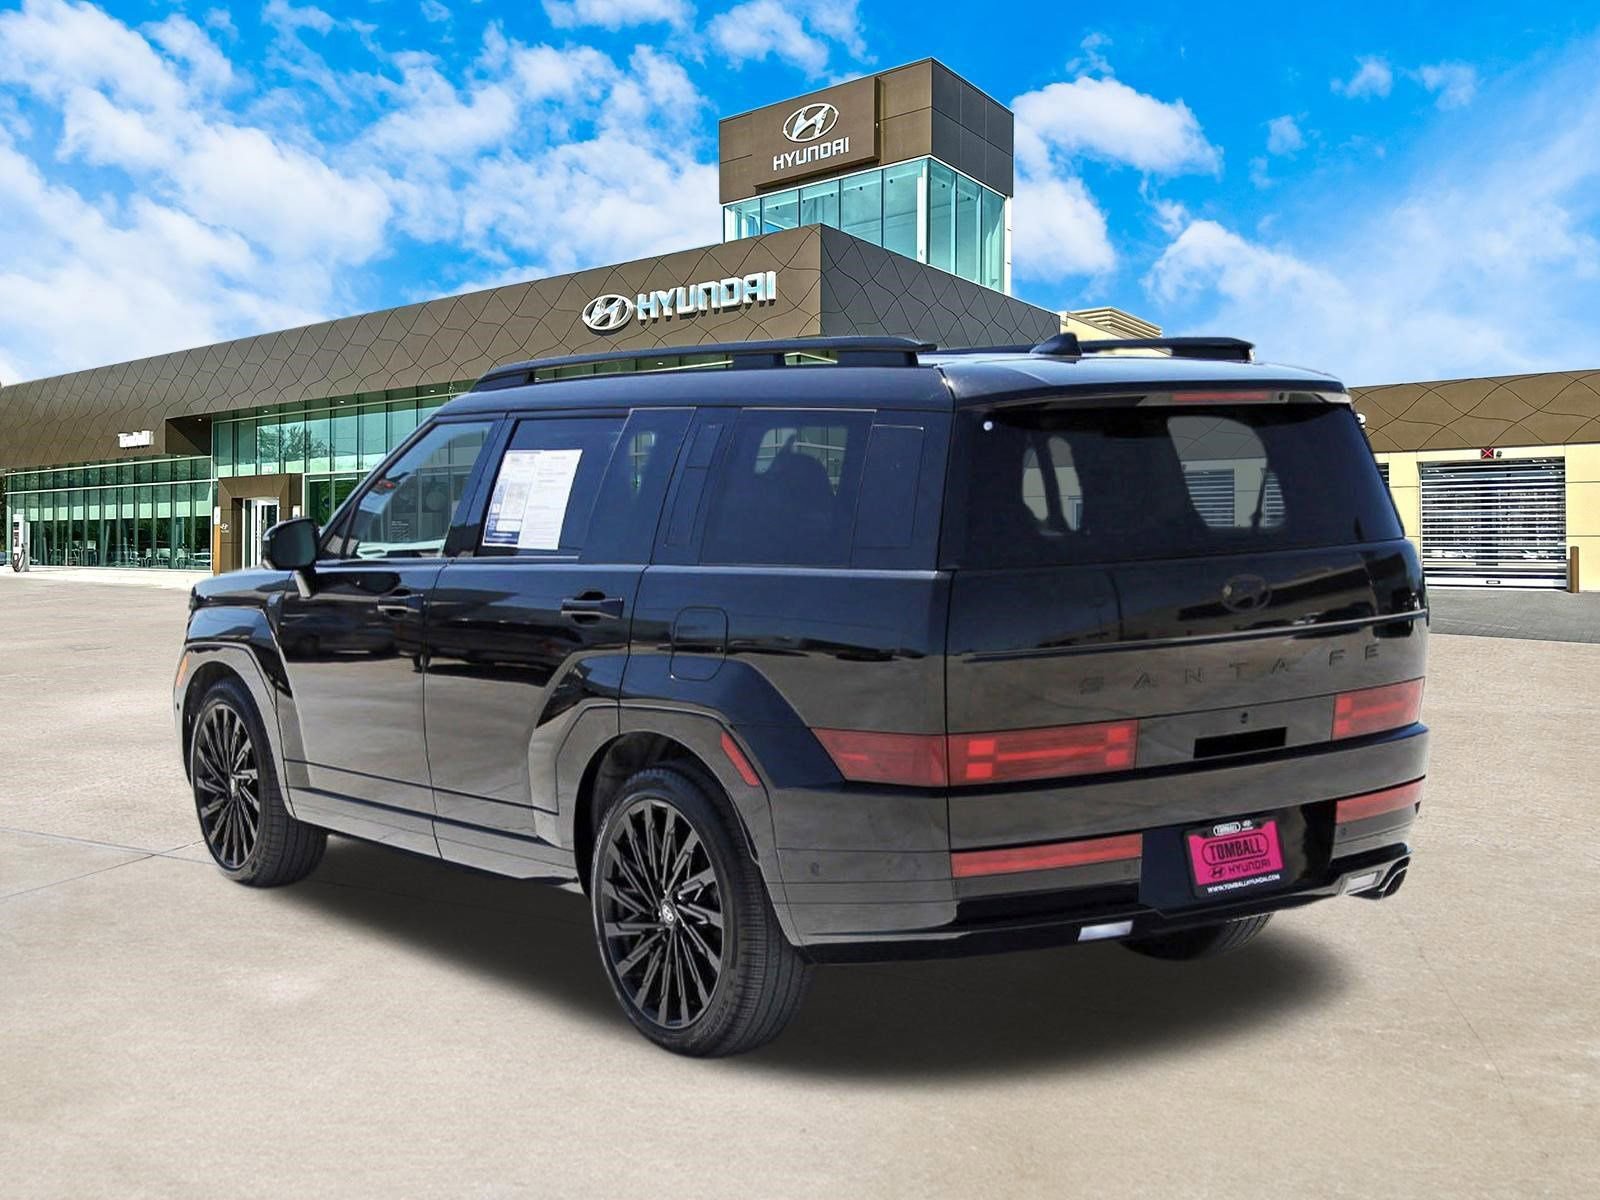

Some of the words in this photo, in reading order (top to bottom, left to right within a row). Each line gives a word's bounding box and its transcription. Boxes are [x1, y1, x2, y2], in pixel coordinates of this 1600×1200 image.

[773, 137, 849, 171] HYUNDAI
[637, 270, 777, 320] HYUNDAI
[1080, 657, 1290, 694] SANTA
[1328, 643, 1380, 667] FE
[1209, 838, 1264, 861] TOMBALL
[1228, 860, 1271, 873] HYUNDAI
